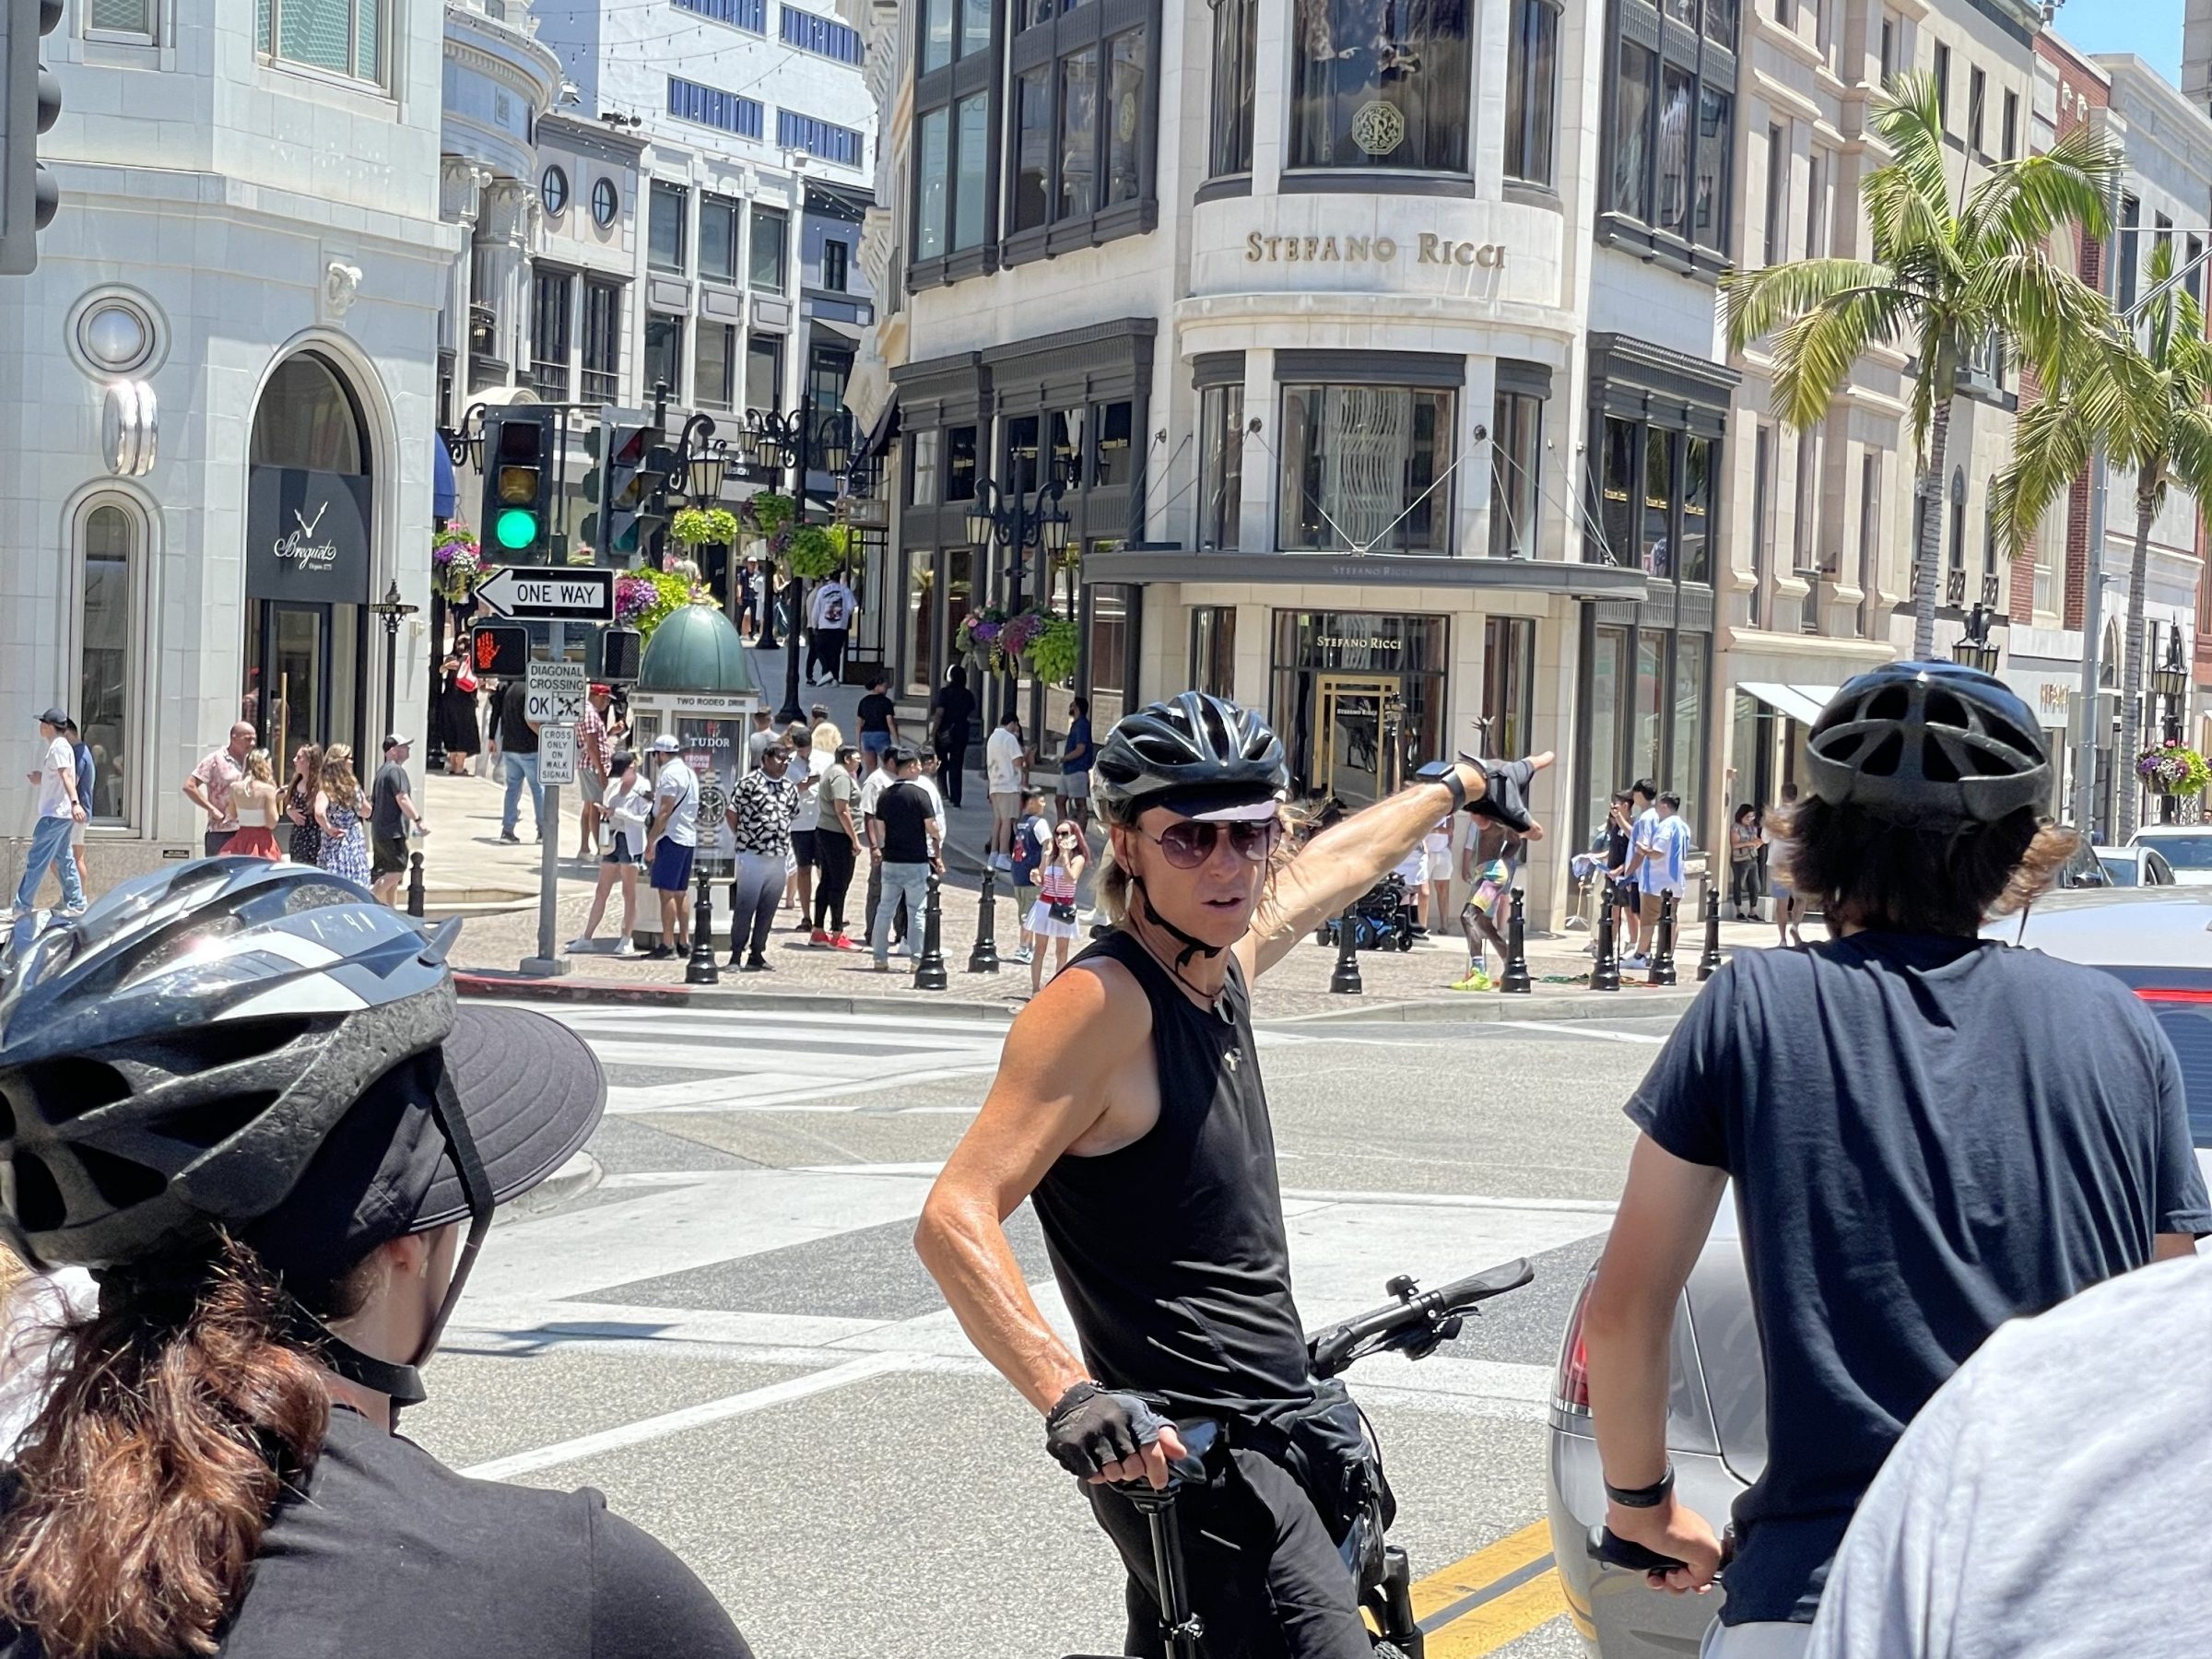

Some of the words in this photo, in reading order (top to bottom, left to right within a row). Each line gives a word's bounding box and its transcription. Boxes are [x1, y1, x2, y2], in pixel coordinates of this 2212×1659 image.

[1245, 231, 1396, 262] STEFANO
[1418, 232, 1506, 268] RICCI
[274, 529, 336, 571] Breguet
[517, 584, 552, 603] ONE
[561, 585, 595, 604] WAY
[1317, 636, 1368, 648] STEFANO
[1371, 638, 1402, 650] RICCI
[531, 665, 582, 677] DIAGONAL
[530, 678, 584, 690] CROSSING
[529, 697, 549, 715] OK
[697, 698, 725, 706] RODEO
[544, 731, 571, 740] CROSS
[547, 741, 568, 749] ONLY
[690, 737, 730, 747] TUDOR
[551, 751, 563, 759] ON
[546, 761, 568, 770] WALK
[542, 771, 571, 780] SIGNAL
